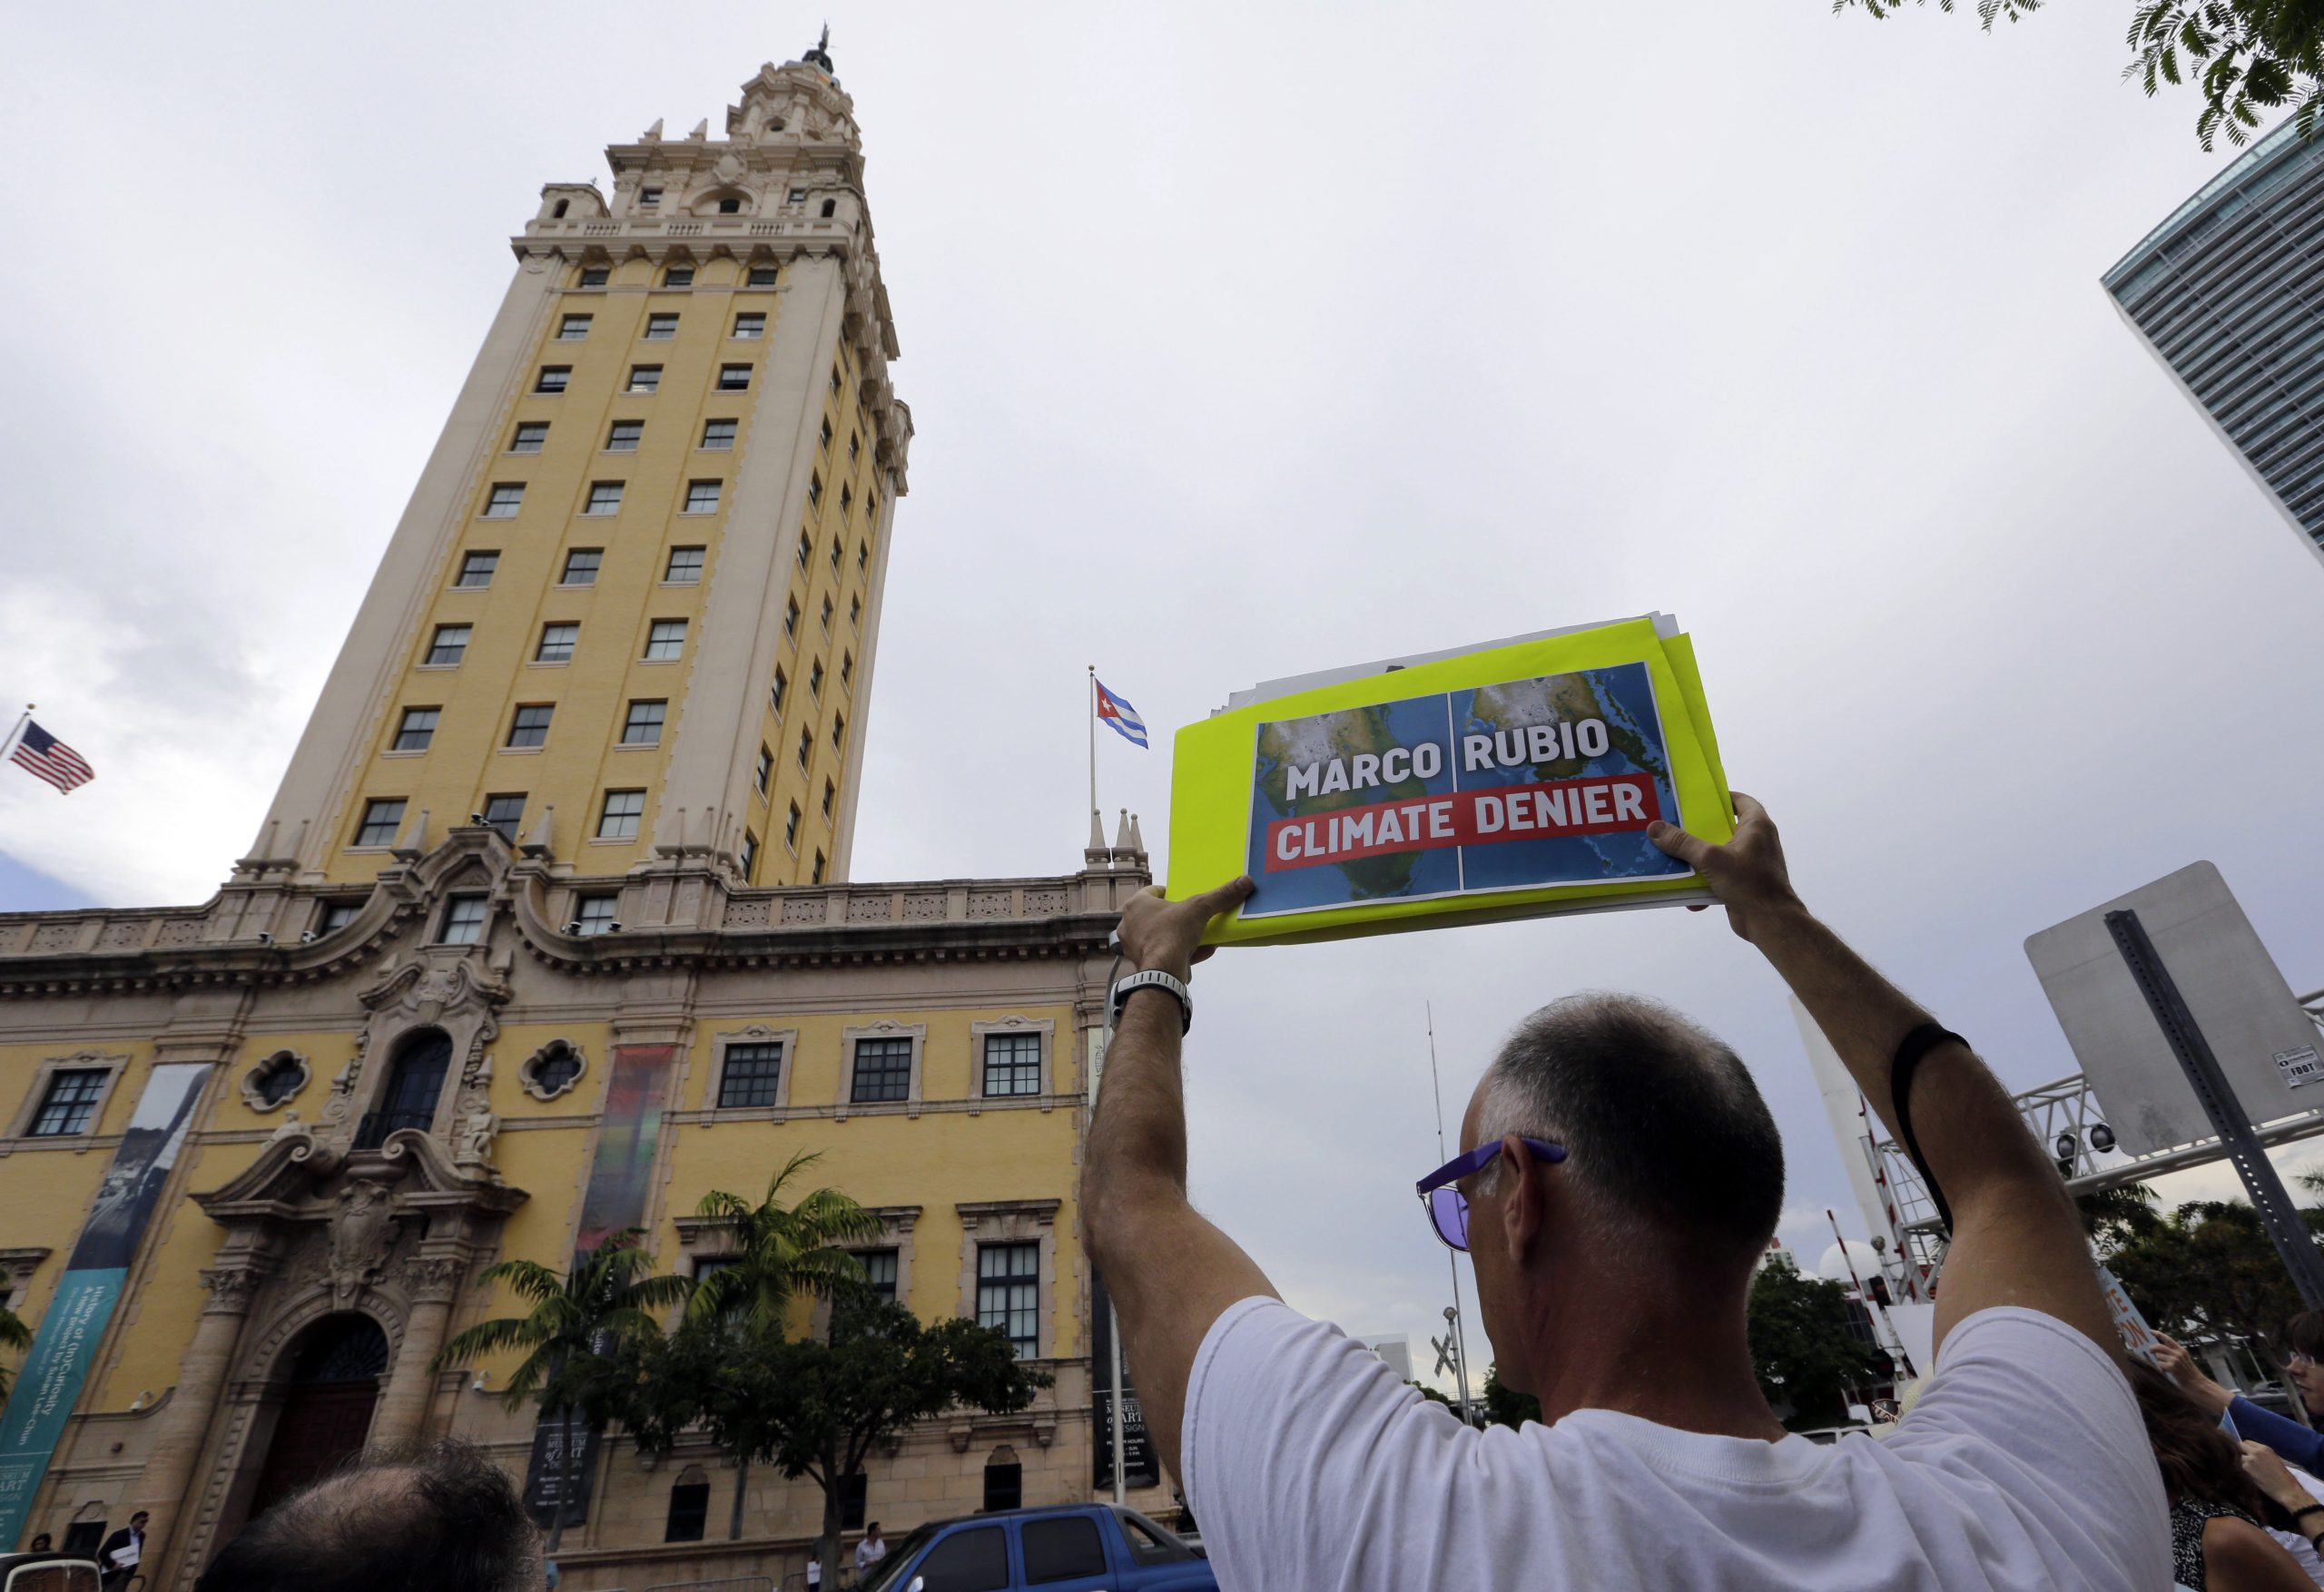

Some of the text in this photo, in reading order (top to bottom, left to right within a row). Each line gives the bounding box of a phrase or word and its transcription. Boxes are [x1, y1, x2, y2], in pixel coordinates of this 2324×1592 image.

[1285, 718, 1610, 801] MARCO RUBIO
[1276, 782, 1647, 861] CLIMATE DENIER
[2290, 1063, 2314, 1076] FDOT
[84, 1286, 94, 1294] A
[74, 1295, 89, 1315] new
[79, 1285, 105, 1325] History
[58, 1316, 78, 1351] project
[73, 1328, 84, 1340] of
[52, 1351, 64, 1364] by
[39, 1365, 59, 1395] Susan
